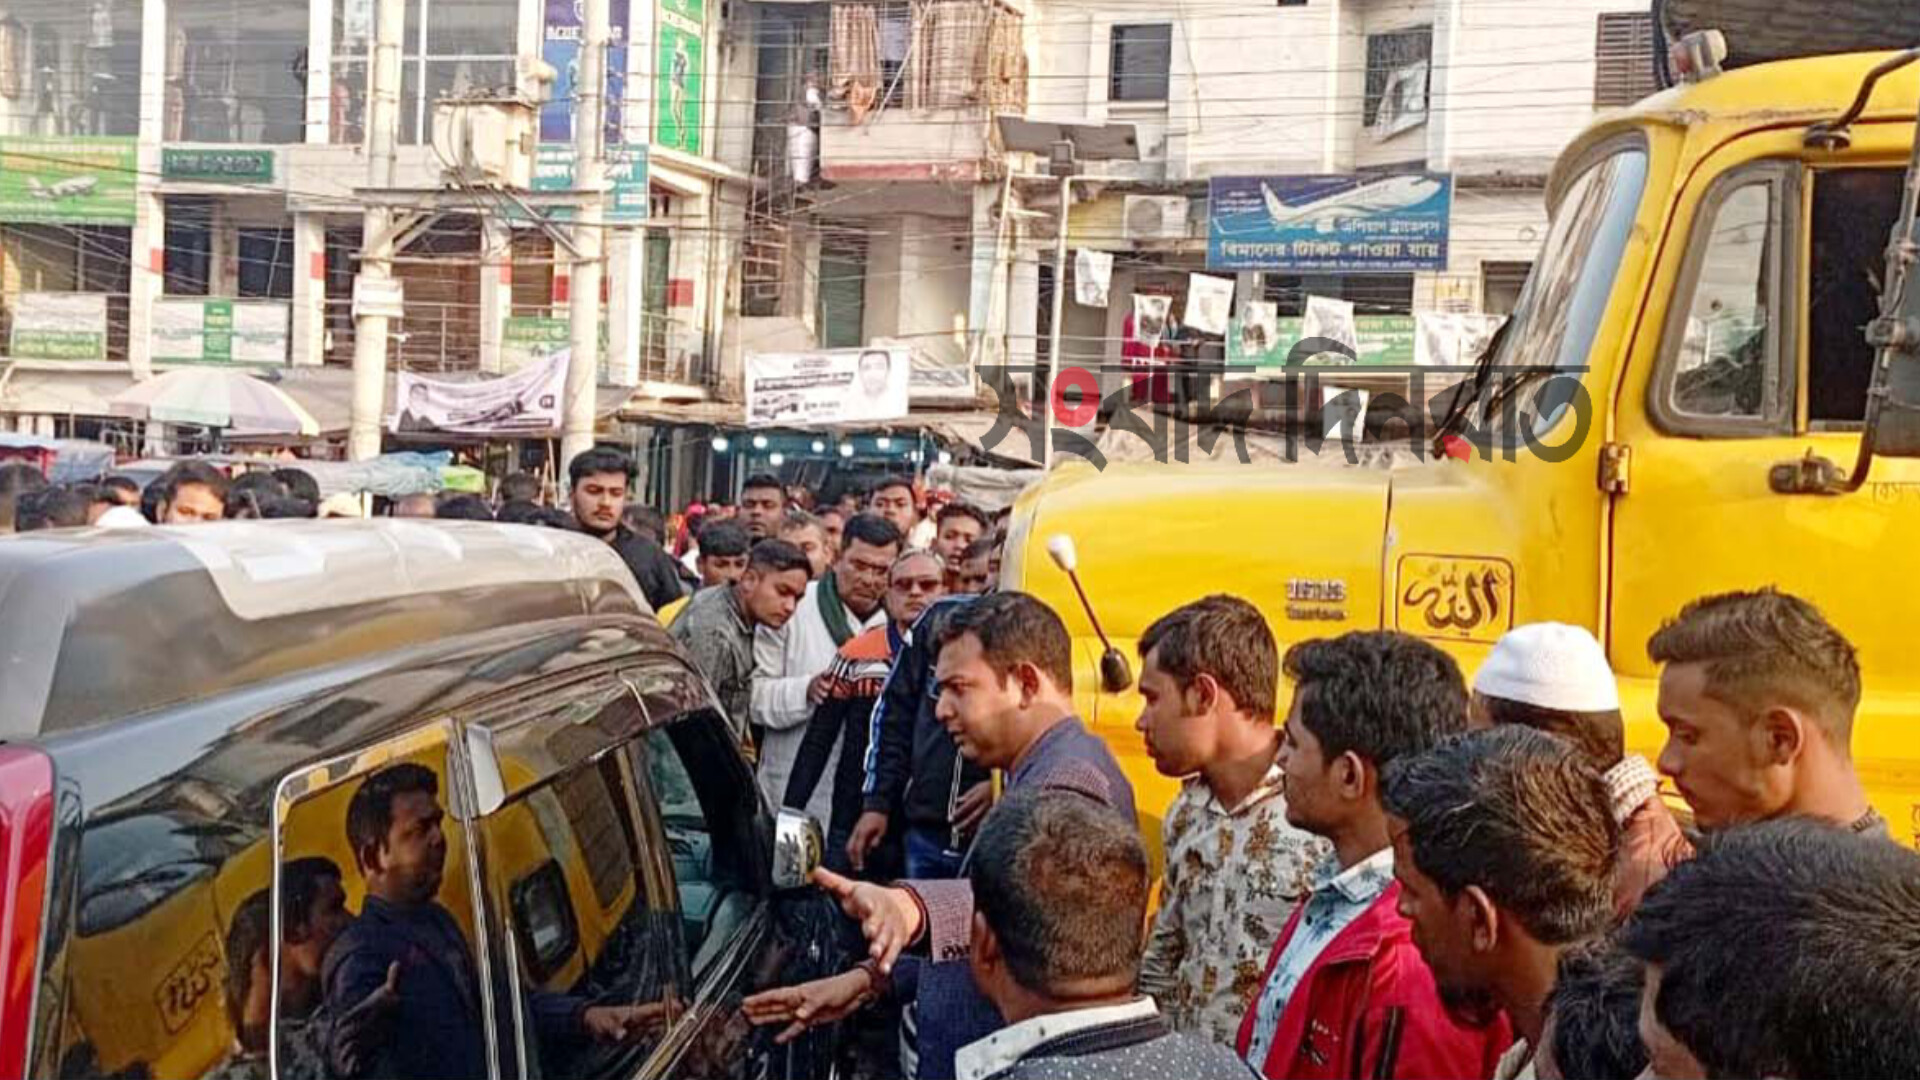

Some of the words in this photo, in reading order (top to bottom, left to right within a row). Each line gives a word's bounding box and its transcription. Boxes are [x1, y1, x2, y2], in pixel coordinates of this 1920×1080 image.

[1220, 239, 1286, 257] বিমানের
[1293, 238, 1342, 257] টিকিট
[1348, 239, 1401, 257] পাওয়া
[1407, 240, 1439, 257] যায়
